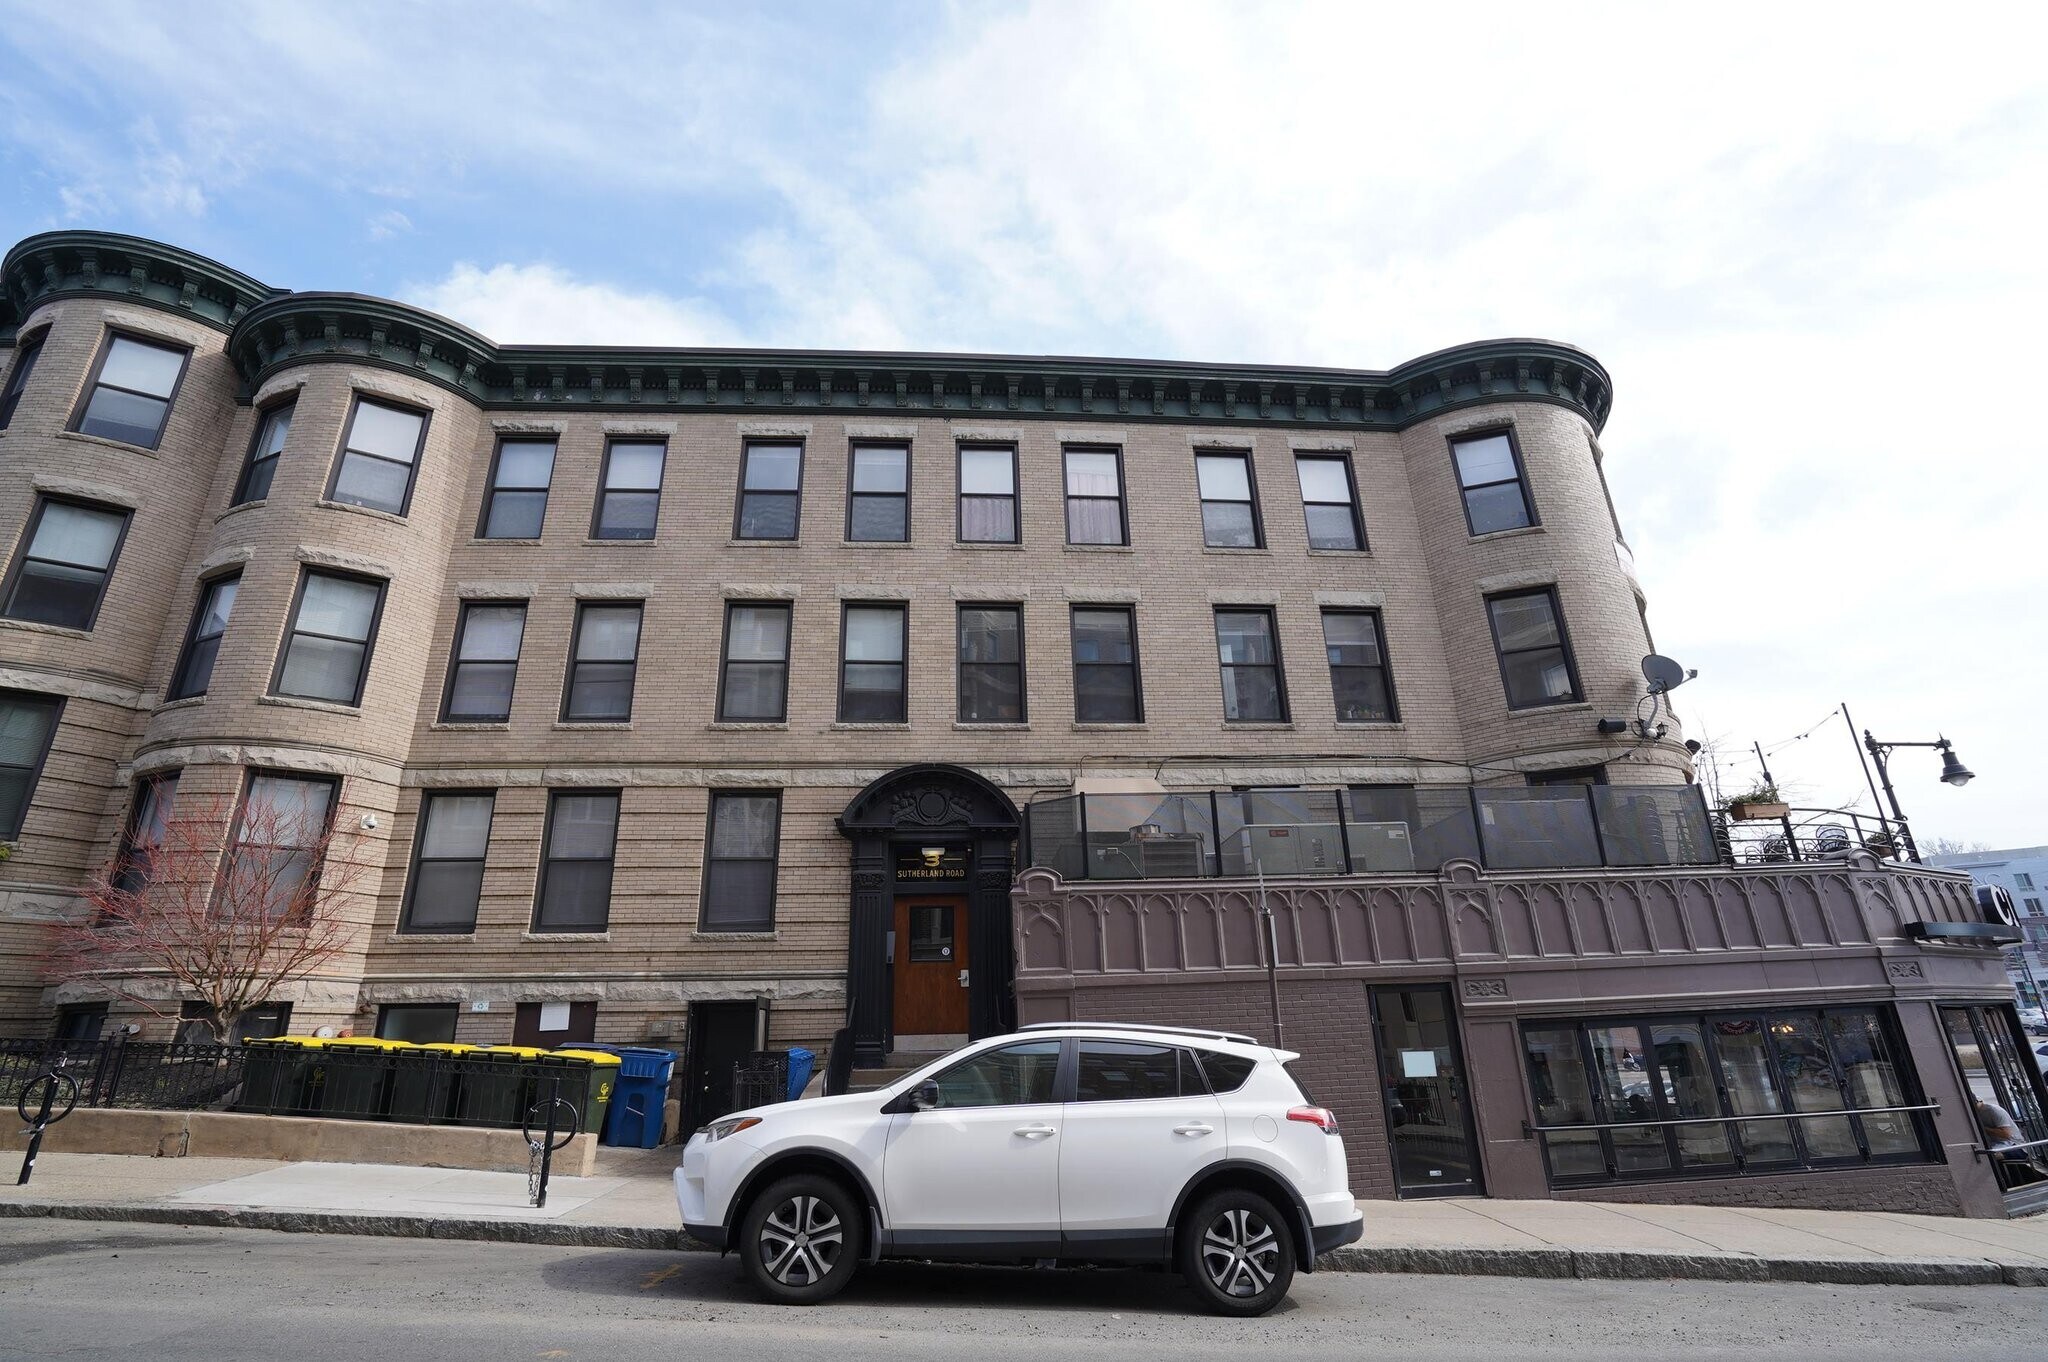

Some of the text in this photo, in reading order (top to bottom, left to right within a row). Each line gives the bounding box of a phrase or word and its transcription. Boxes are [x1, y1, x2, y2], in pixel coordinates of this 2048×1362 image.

[924, 853, 940, 867] 3
[897, 869, 965, 878] SUTHERLAND ROAD
